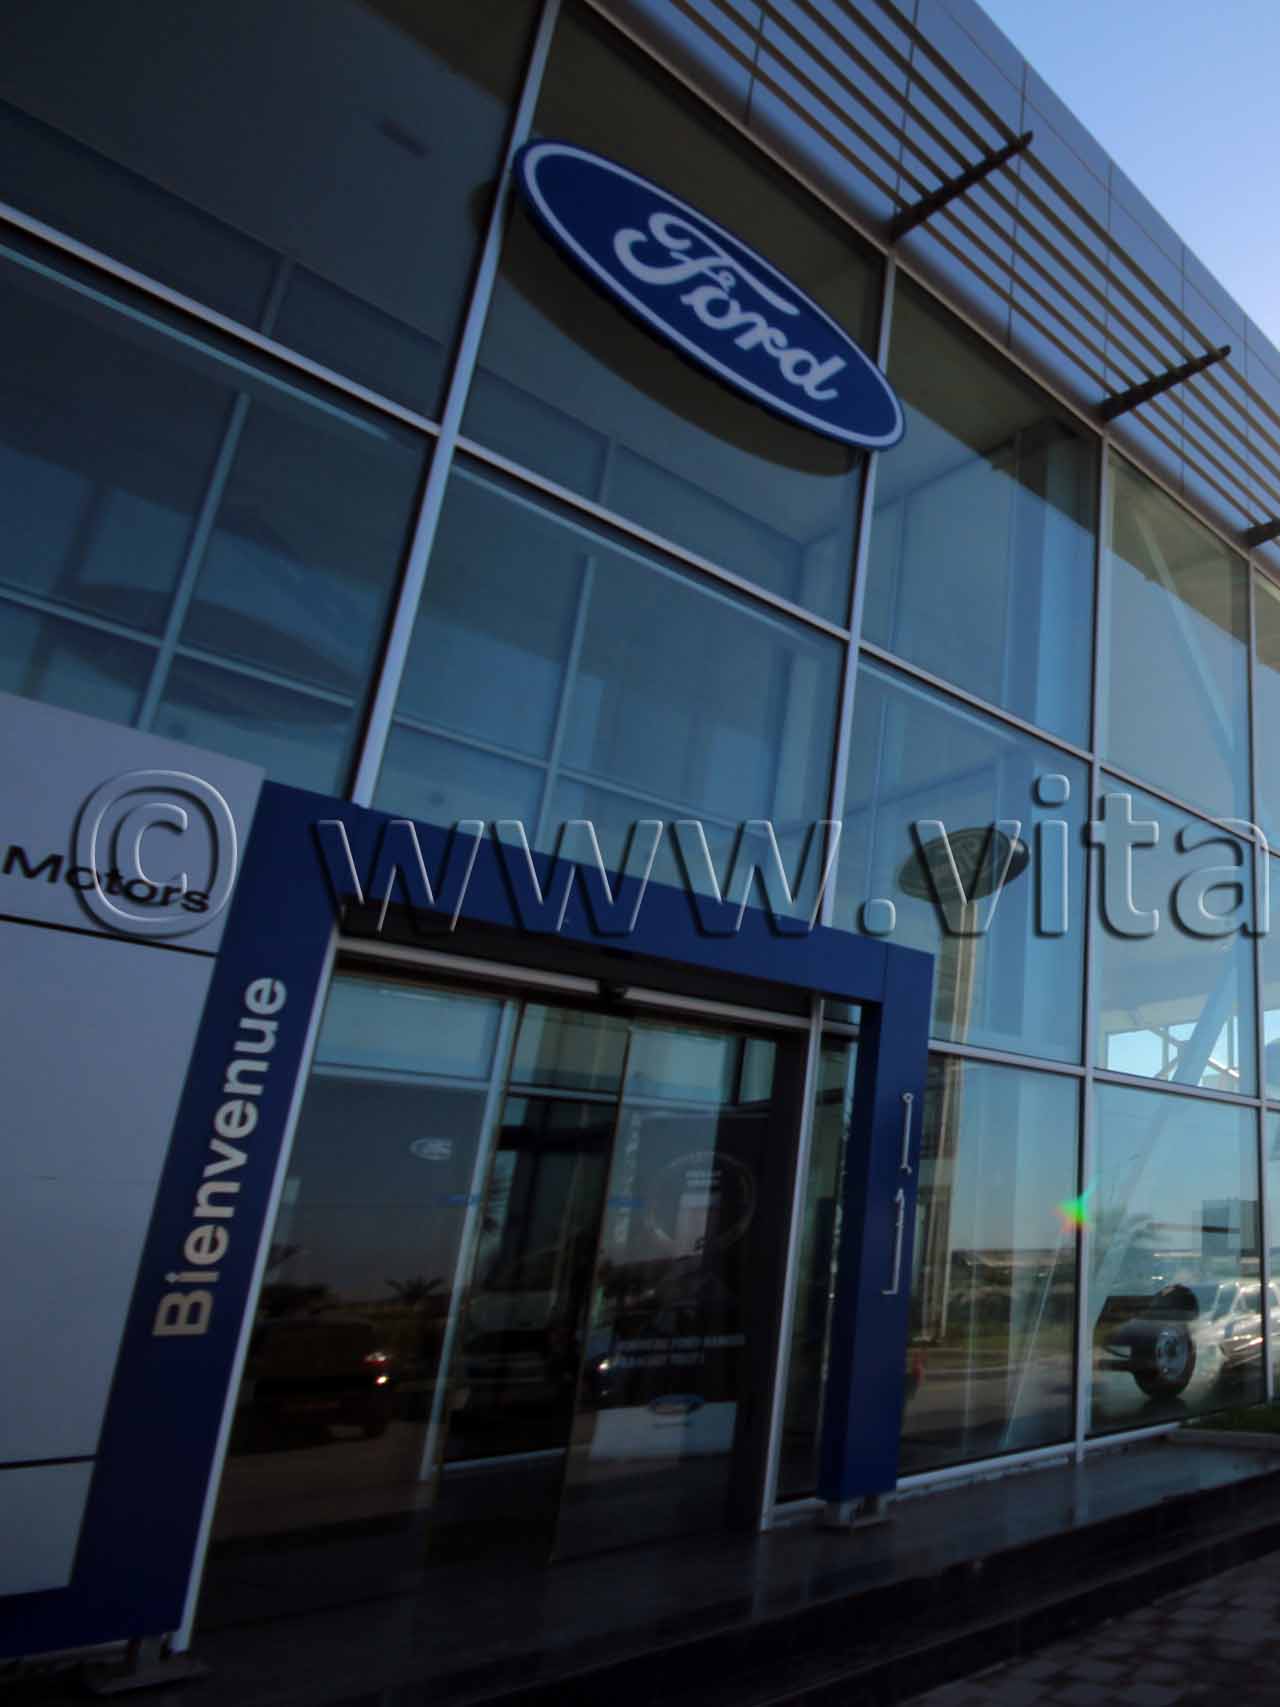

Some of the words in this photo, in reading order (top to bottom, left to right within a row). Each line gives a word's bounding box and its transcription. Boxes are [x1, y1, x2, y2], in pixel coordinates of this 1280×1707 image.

[612, 211, 847, 401] Ford
[1, 844, 211, 914] Motors
[151, 976, 288, 1337] Bienvenue
